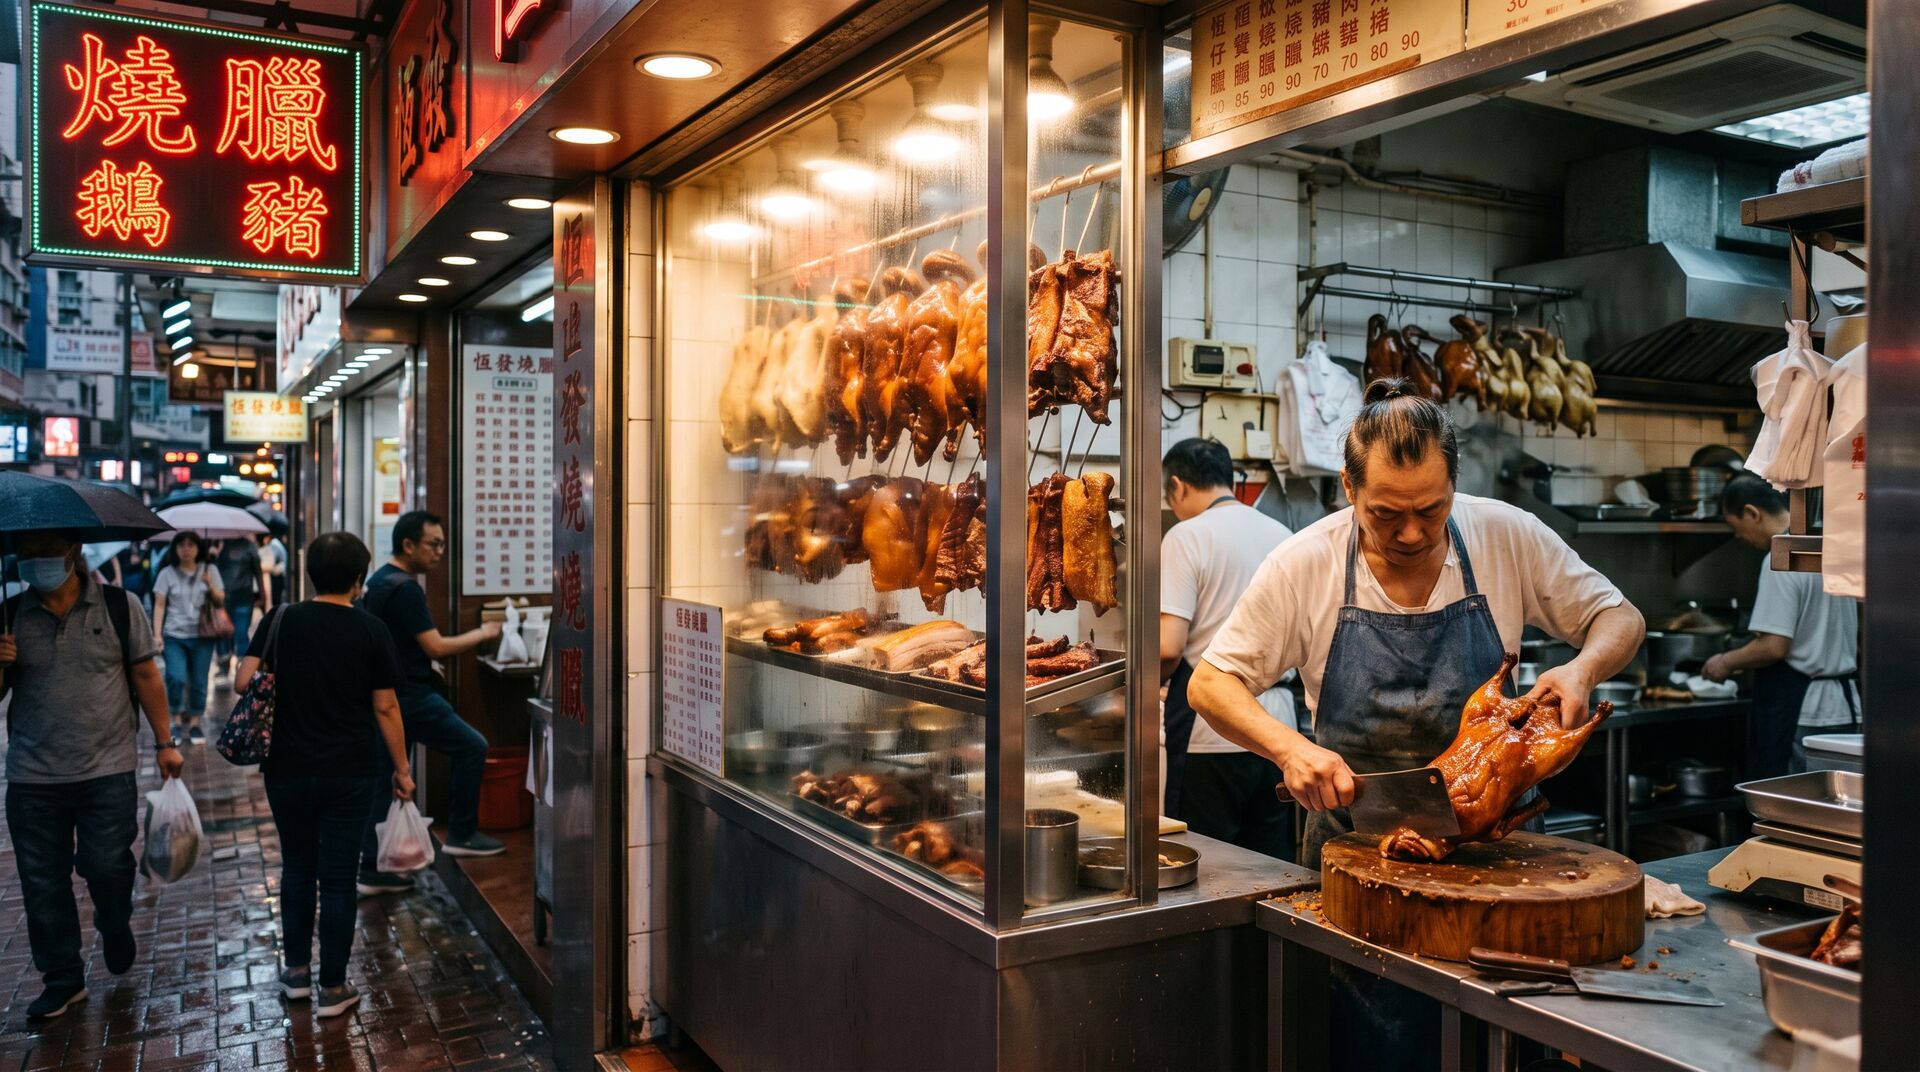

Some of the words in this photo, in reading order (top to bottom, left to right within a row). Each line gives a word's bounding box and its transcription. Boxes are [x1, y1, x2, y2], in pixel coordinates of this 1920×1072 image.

[1235, 90, 1249, 108] 85
[1260, 81, 1275, 99] 90
[1286, 72, 1301, 91] 90
[1313, 62, 1329, 81] 70
[1341, 52, 1358, 71] 70
[1371, 41, 1388, 61] 80
[1402, 30, 1420, 51] 90
